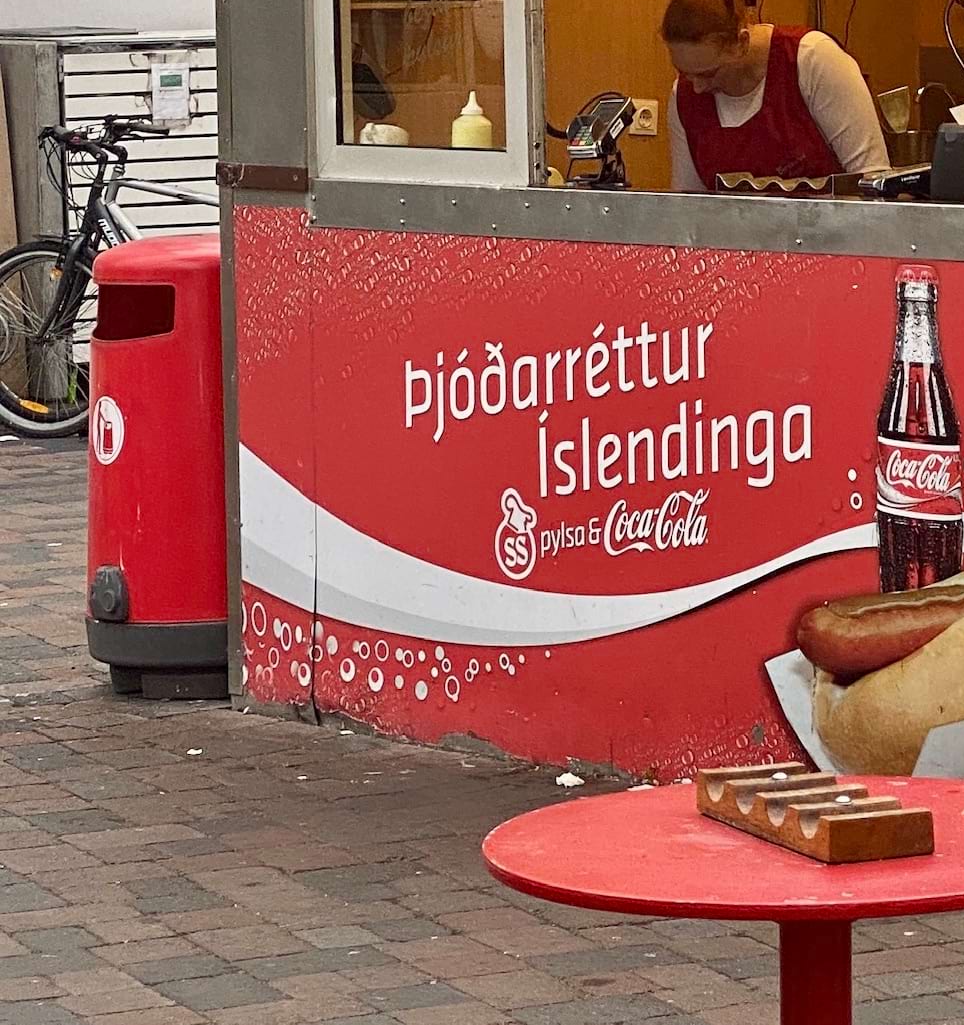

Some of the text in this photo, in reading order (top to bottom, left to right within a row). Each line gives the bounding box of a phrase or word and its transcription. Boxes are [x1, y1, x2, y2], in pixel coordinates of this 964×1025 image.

[405, 322, 714, 443] Þjóðarréttur
[538, 400, 812, 498] Íslendinga
[886, 449, 953, 491] Coca-Cola
[504, 535, 530, 567] SS
[540, 488, 710, 558] pylsa & Coca-Cola
